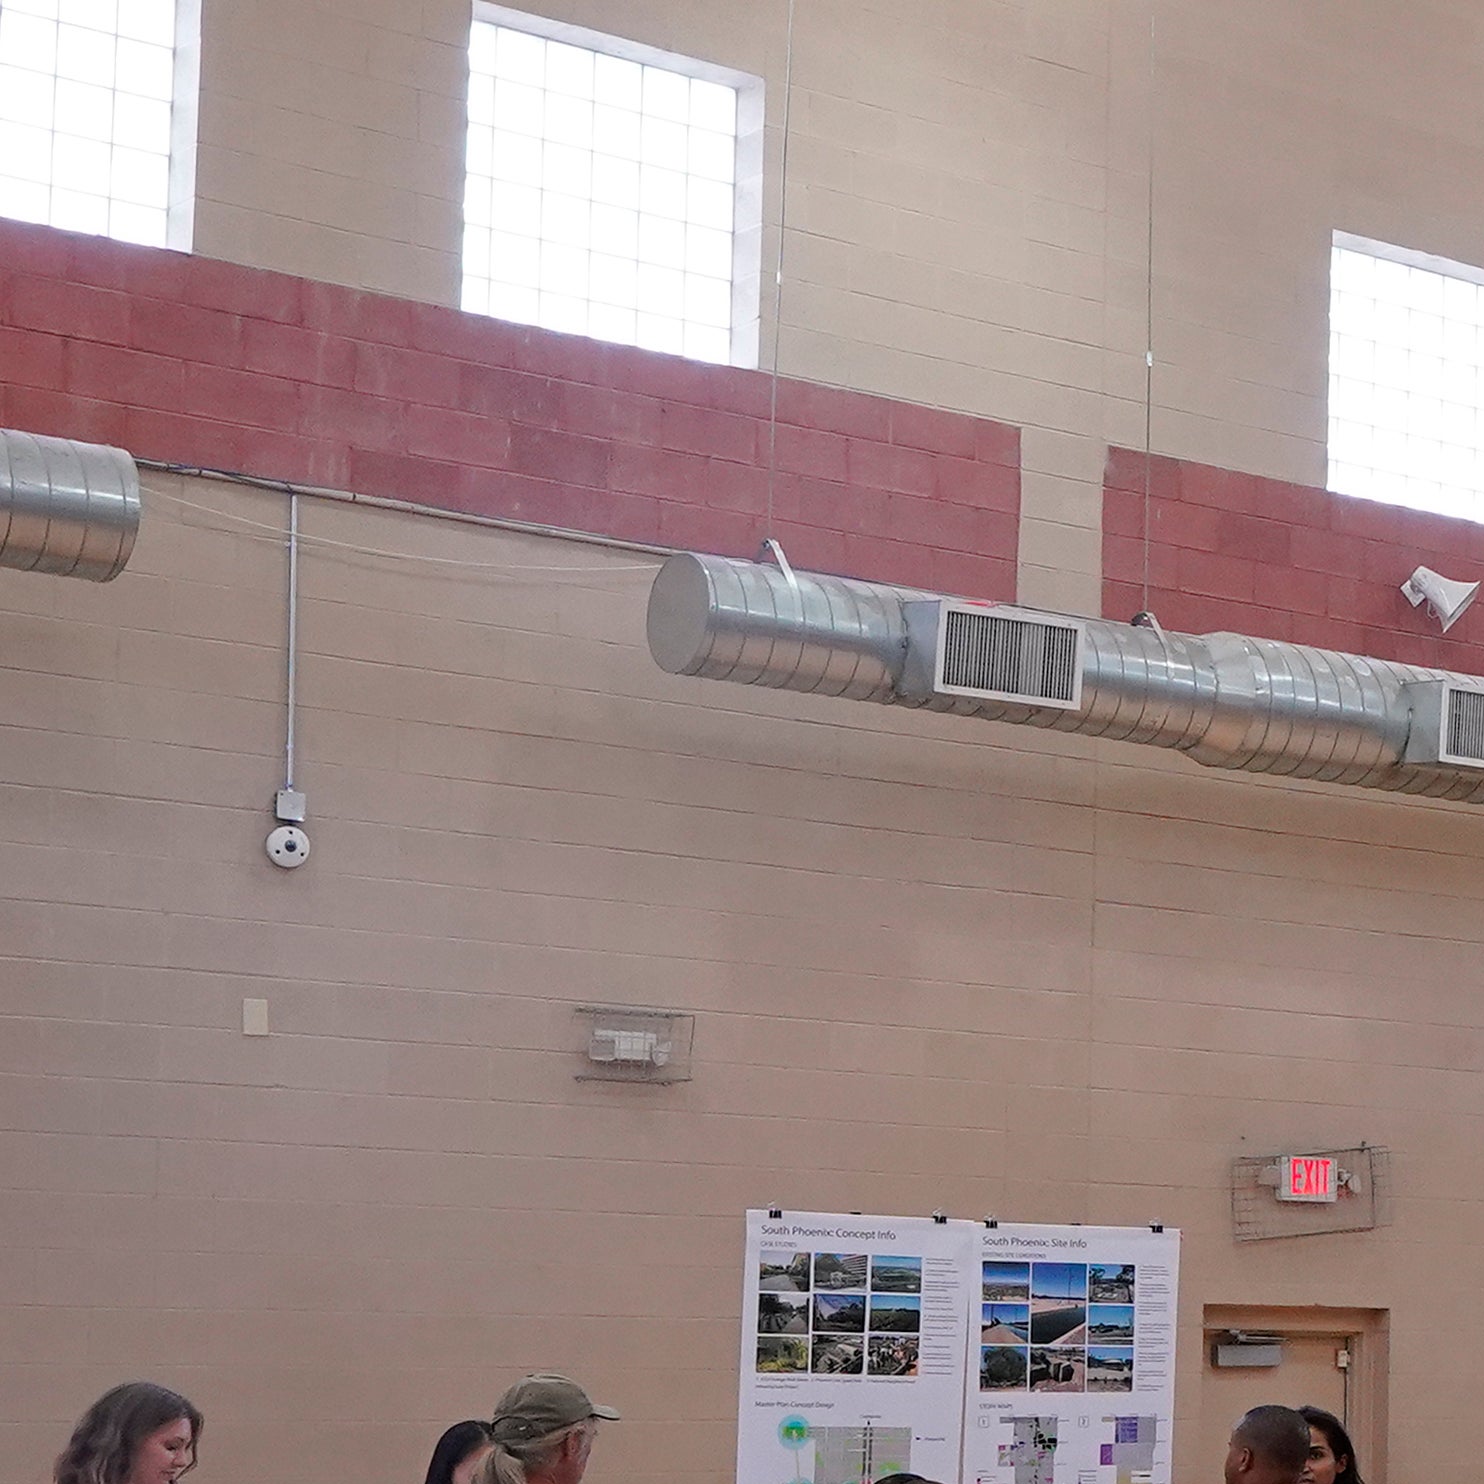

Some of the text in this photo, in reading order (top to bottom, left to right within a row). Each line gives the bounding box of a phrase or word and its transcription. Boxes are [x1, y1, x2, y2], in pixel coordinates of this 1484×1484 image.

[1291, 1157, 1331, 1195] EXIT
[761, 1225, 790, 1235] South
[836, 1228, 876, 1240] Concept
[877, 1230, 896, 1240] Info
[982, 1236, 1009, 1246] South
[1051, 1238, 1068, 1248] Site
[1069, 1239, 1087, 1249] Info
